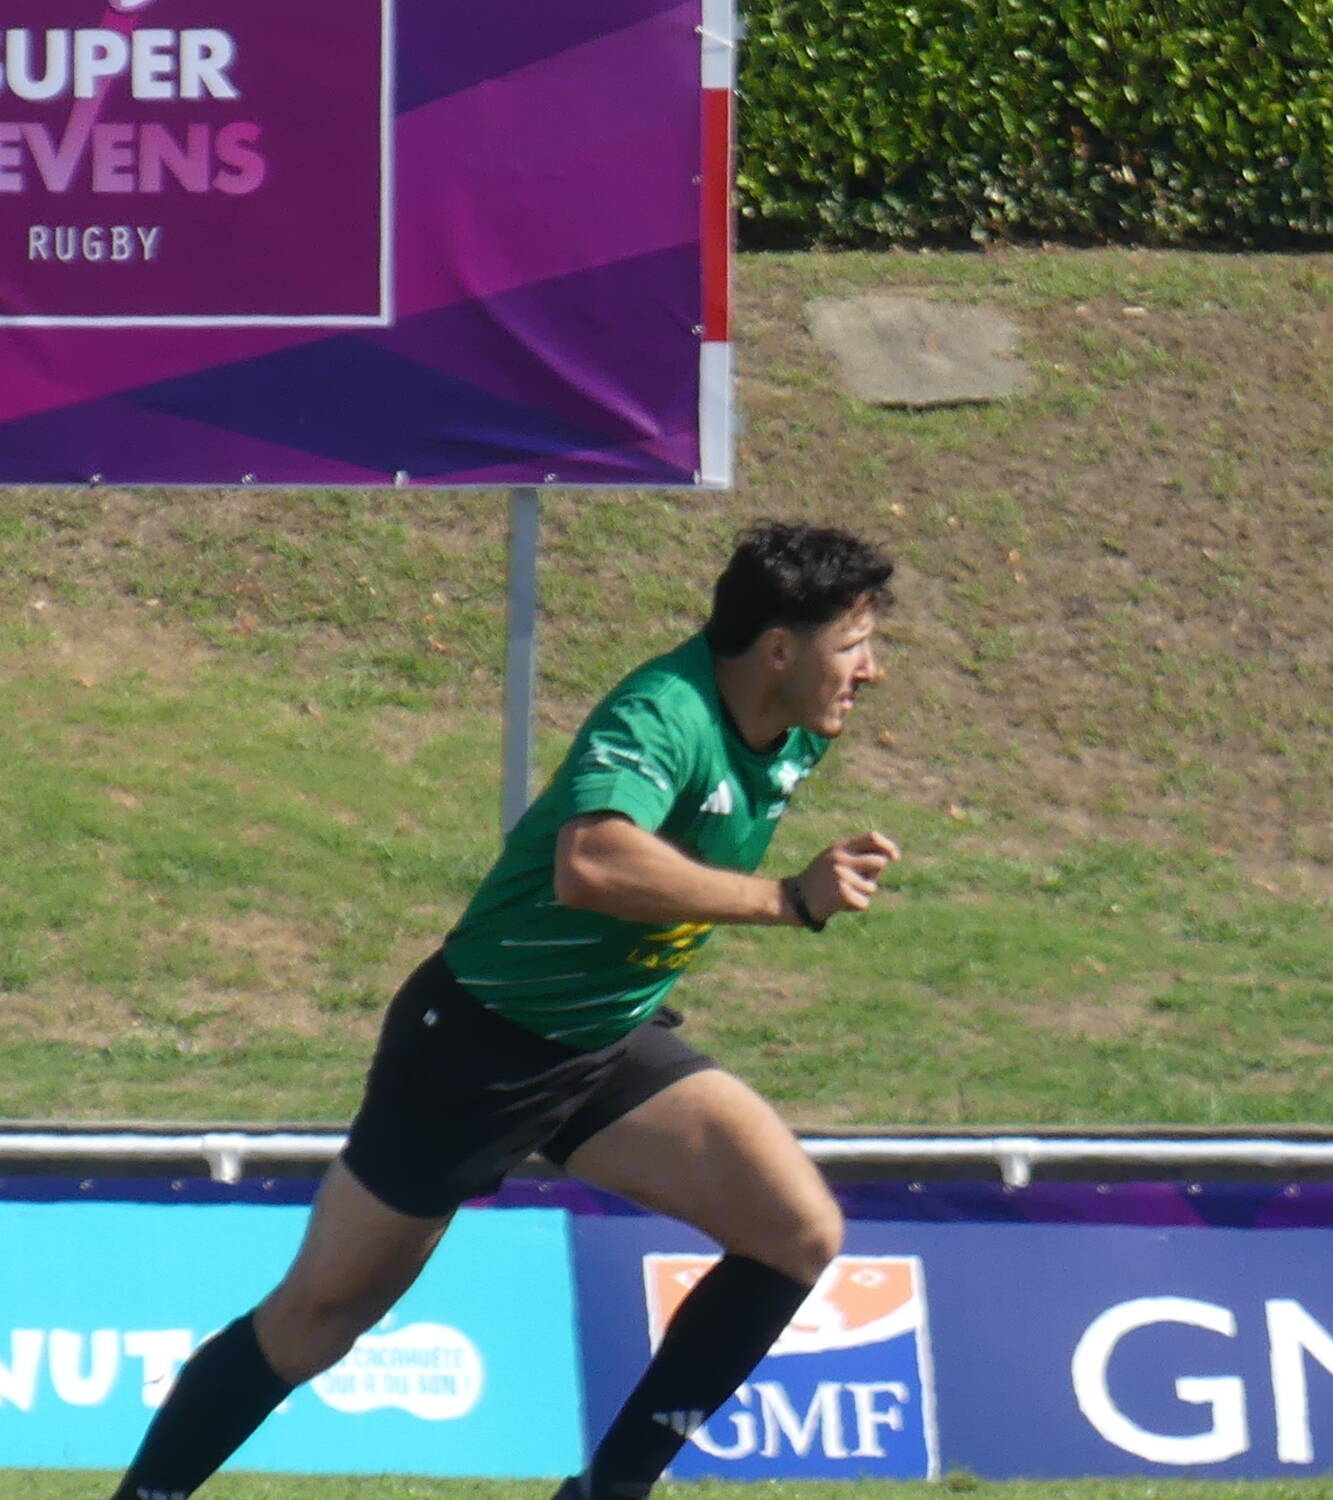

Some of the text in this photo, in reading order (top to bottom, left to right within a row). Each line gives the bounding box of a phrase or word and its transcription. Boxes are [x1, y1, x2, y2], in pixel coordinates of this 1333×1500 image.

[0, 29, 240, 101] UPER
[28, 225, 158, 261] RUGBY
[0, 1328, 222, 1412] NUT
[683, 1381, 909, 1460] GMF
